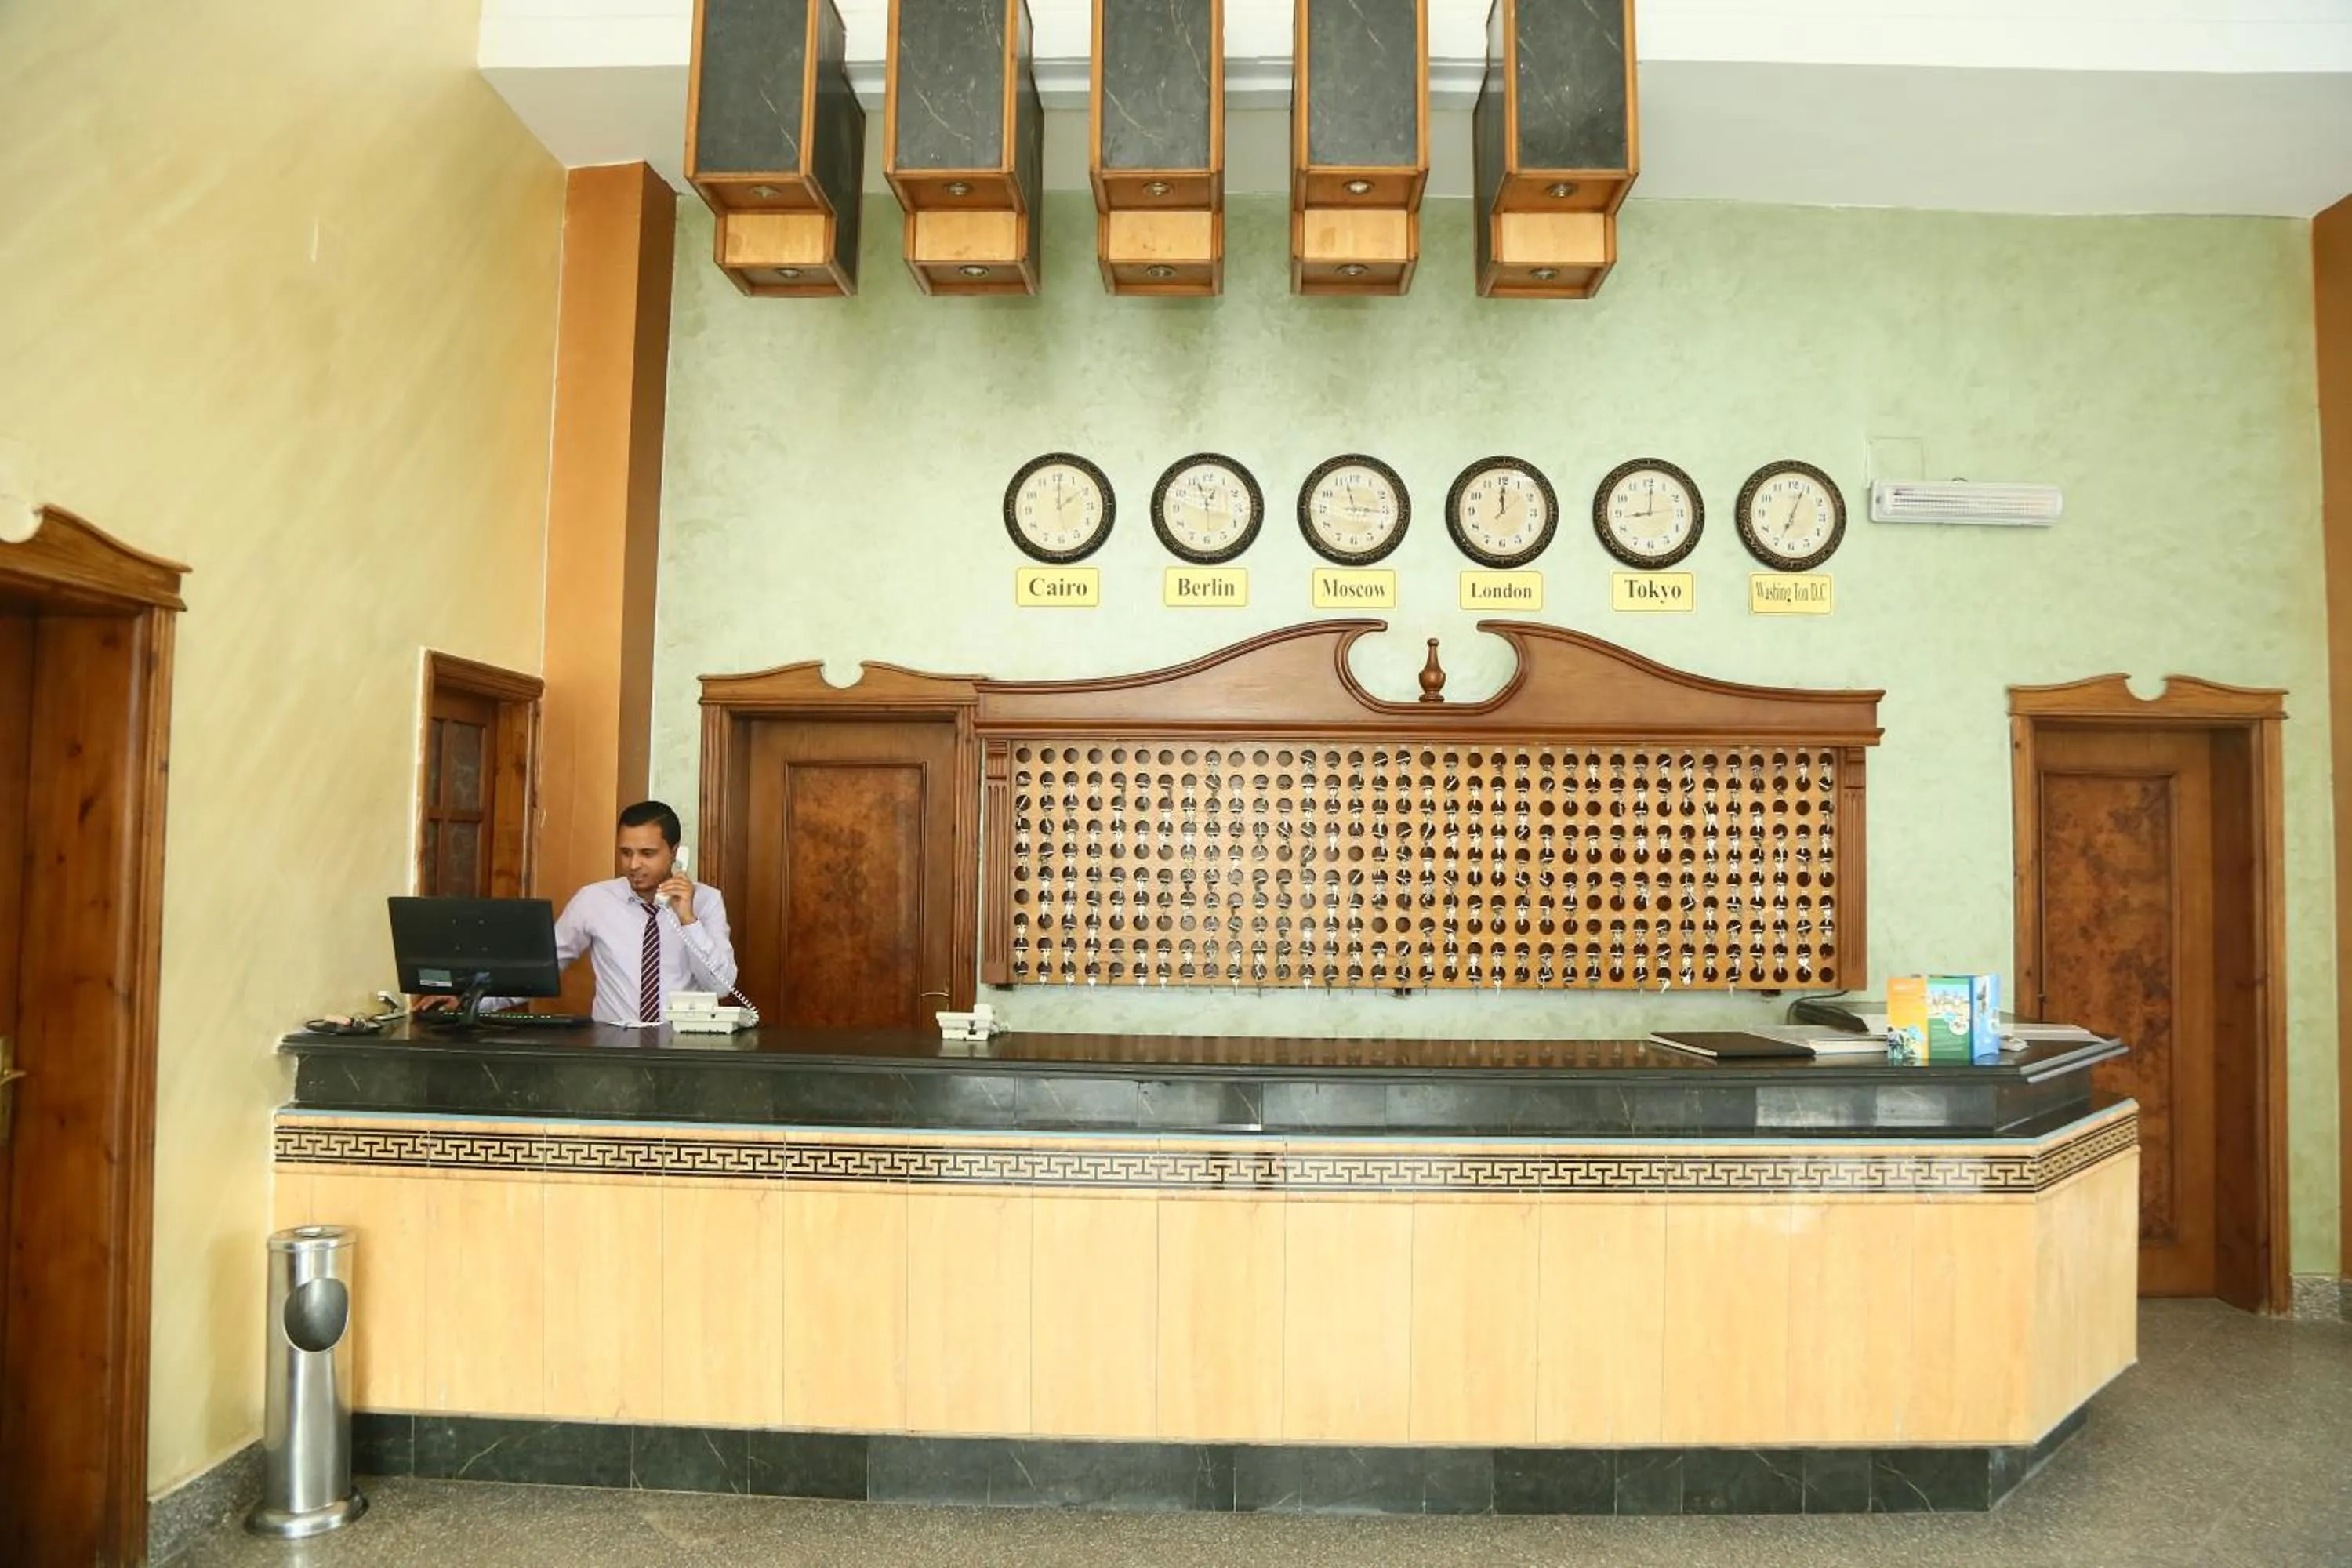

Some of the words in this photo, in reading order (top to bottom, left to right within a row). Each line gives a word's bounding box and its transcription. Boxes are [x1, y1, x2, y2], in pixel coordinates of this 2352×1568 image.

[1029, 577, 1087, 597] Cairo
[1178, 578, 1235, 597] Berlin
[1322, 579, 1386, 597] Moscow
[1472, 583, 1532, 598] London
[1624, 579, 1682, 604] Tokyo
[1755, 581, 1791, 603] Washing
